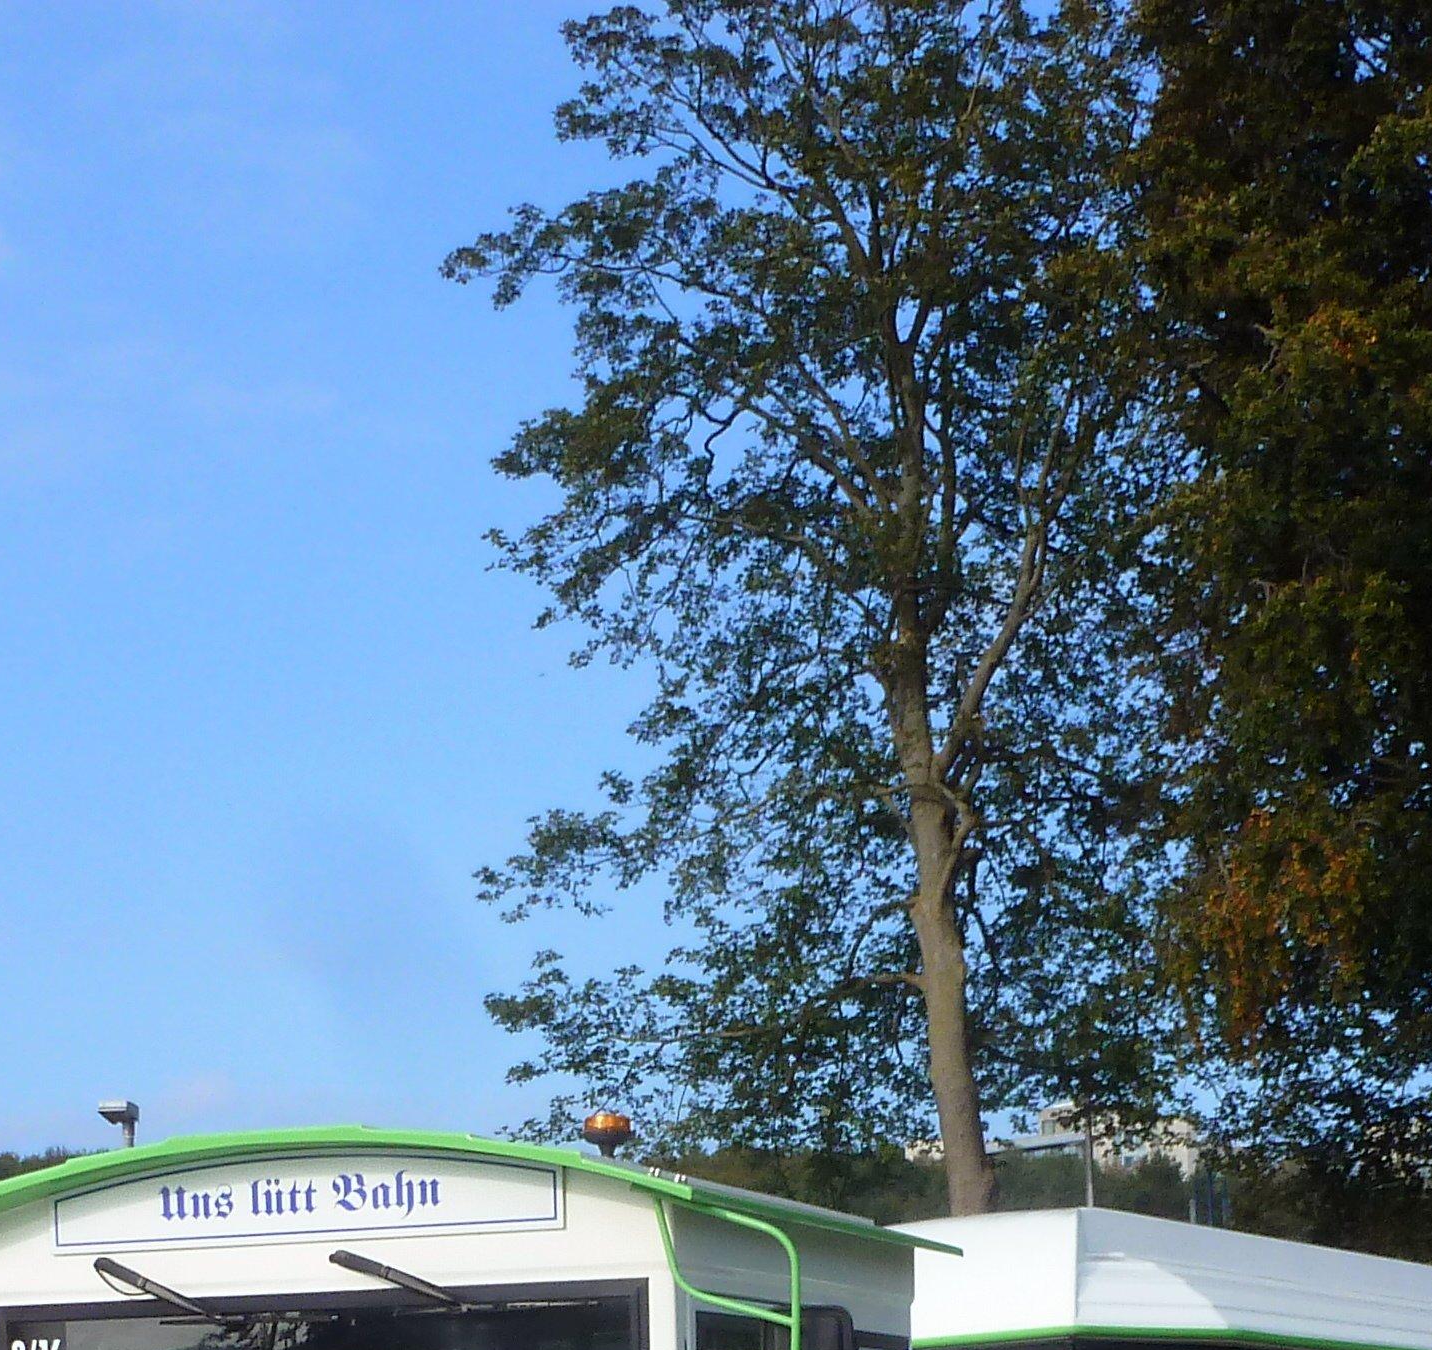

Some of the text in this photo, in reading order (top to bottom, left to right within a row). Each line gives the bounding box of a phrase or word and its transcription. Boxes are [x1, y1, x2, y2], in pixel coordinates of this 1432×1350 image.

[159, 1169, 441, 1221] Uns lütt Bahn
